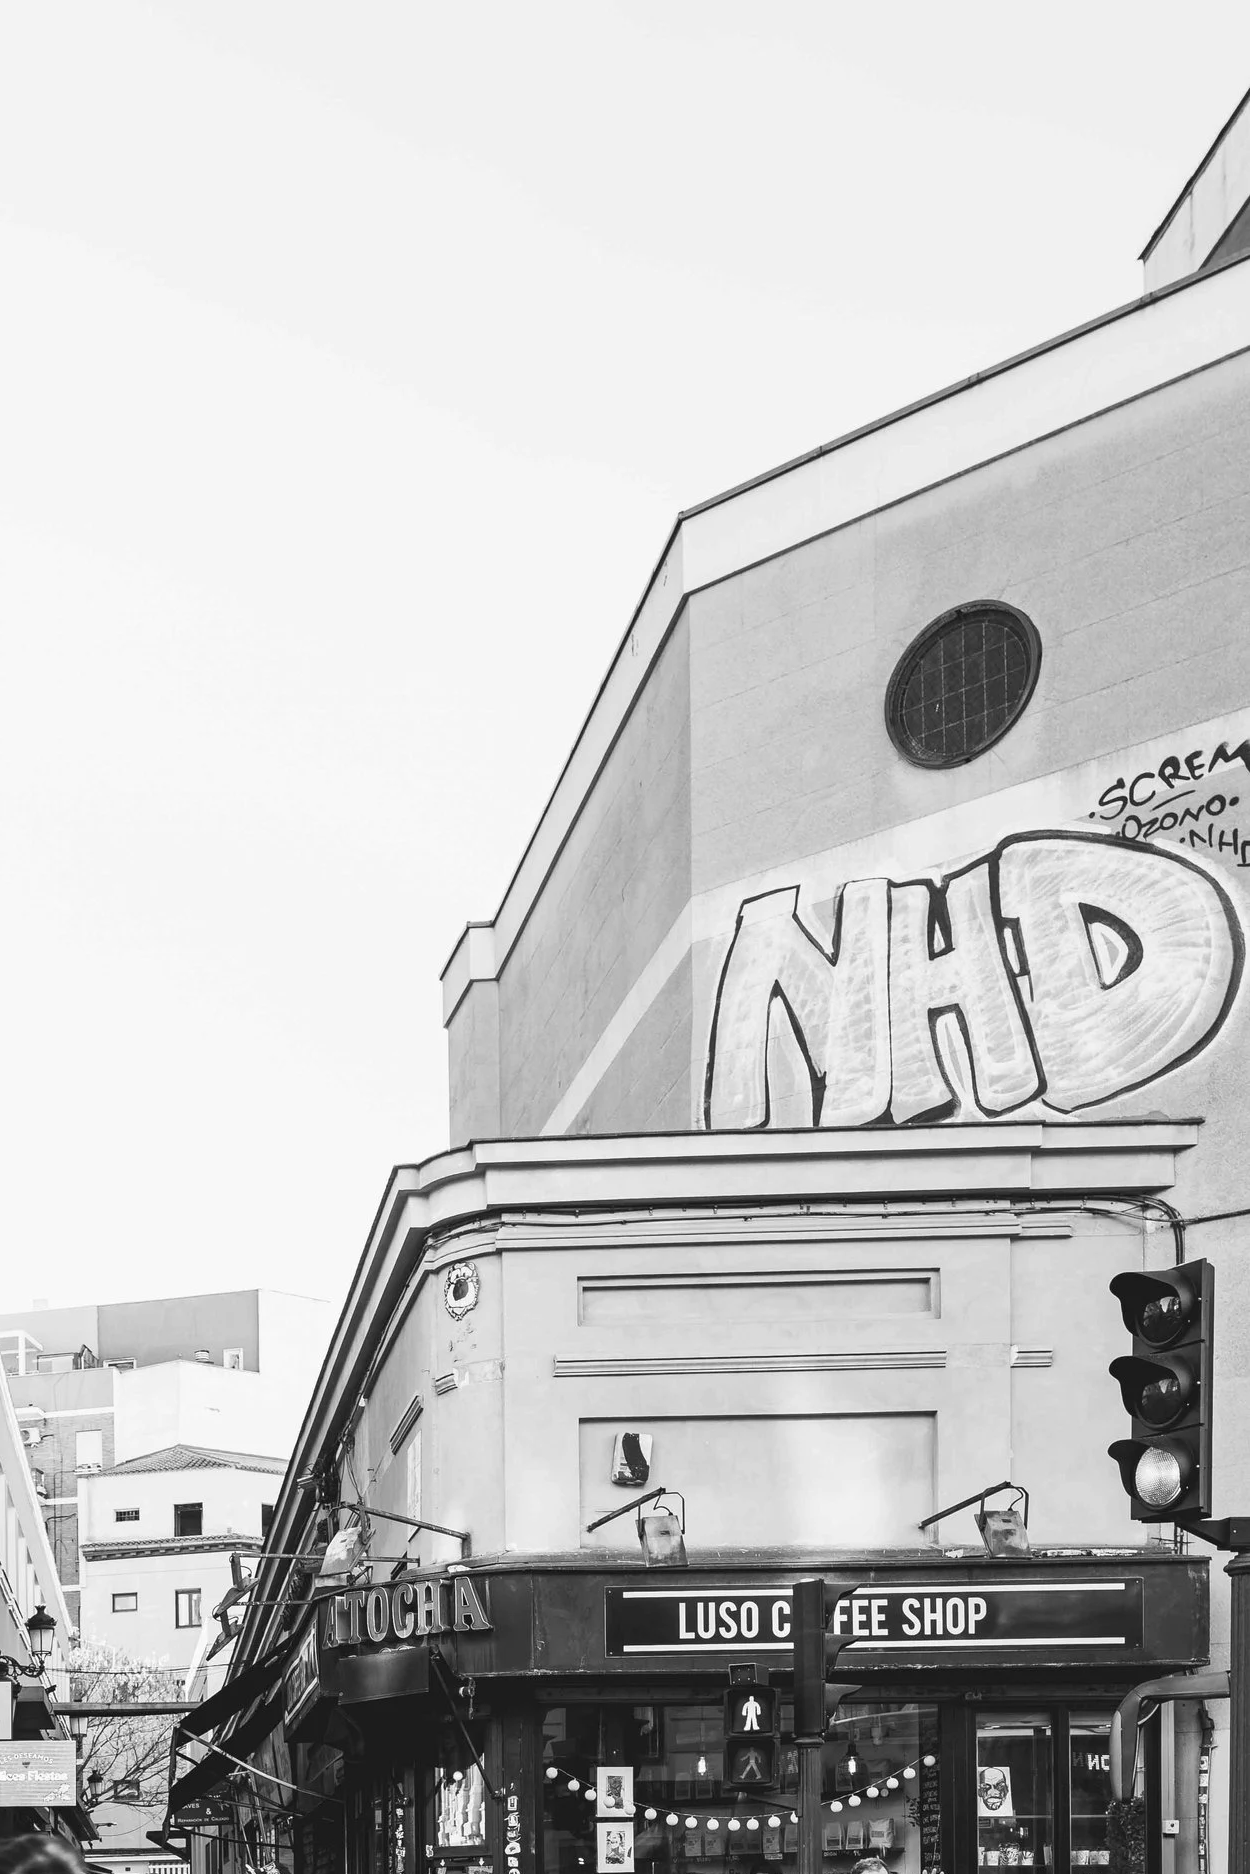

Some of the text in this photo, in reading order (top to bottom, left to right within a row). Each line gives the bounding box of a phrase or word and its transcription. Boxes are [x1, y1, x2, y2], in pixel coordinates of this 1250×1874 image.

[704, 829, 1246, 1131] NHD
[321, 1576, 494, 1650] ATOCHA
[679, 1597, 988, 1640] LUSO CFEE SHOP
[27, 1770, 69, 1781] Fiestas
[205, 1807, 212, 1815] &
